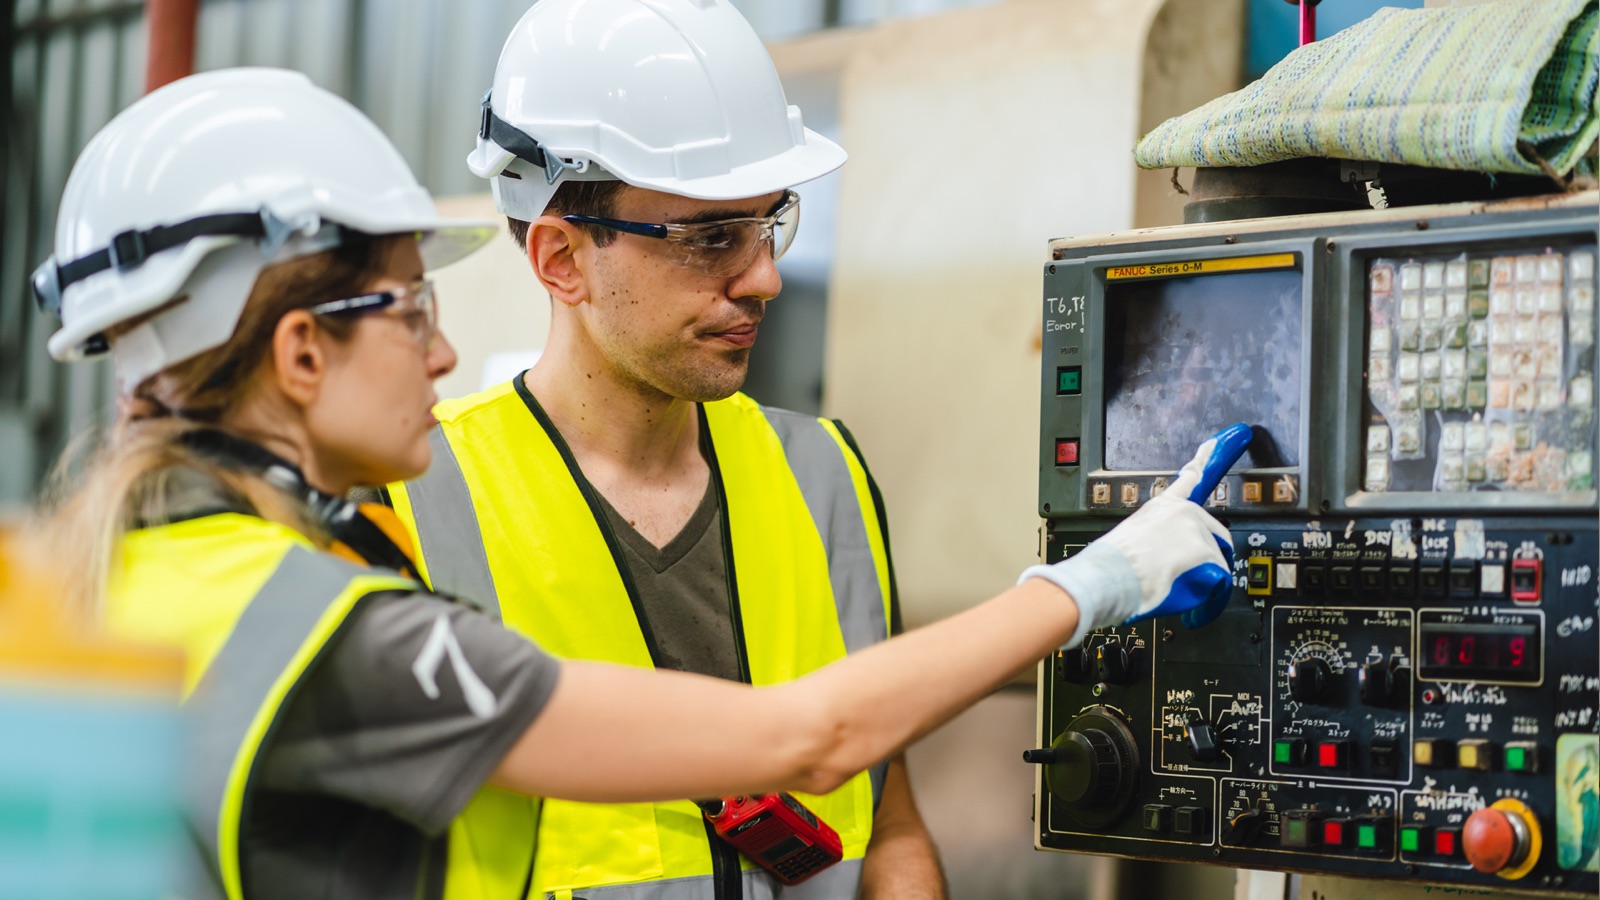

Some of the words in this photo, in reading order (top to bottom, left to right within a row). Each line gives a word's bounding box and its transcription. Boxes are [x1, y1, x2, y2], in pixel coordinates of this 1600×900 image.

[1113, 266, 1146, 277] FANUC
[1150, 264, 1179, 275] Series
[1062, 550, 1068, 558] X
[1111, 626, 1116, 634] Y
[1131, 627, 1137, 635] Z
[1509, 636, 1526, 667] 9
[1237, 692, 1250, 701] MDI
[1168, 704, 1190, 712] ハンドル
[1302, 719, 1329, 727] プログラム
[1283, 727, 1303, 735] スタート
[1328, 729, 1350, 737] ストップ
[1229, 781, 1267, 790] オーバーライド
[1239, 789, 1246, 797] 80
[1261, 791, 1268, 799] 90
[1233, 800, 1240, 808] 70
[1265, 802, 1275, 811] 100
[1446, 813, 1463, 824] OFF
[1269, 825, 1279, 834] 120
